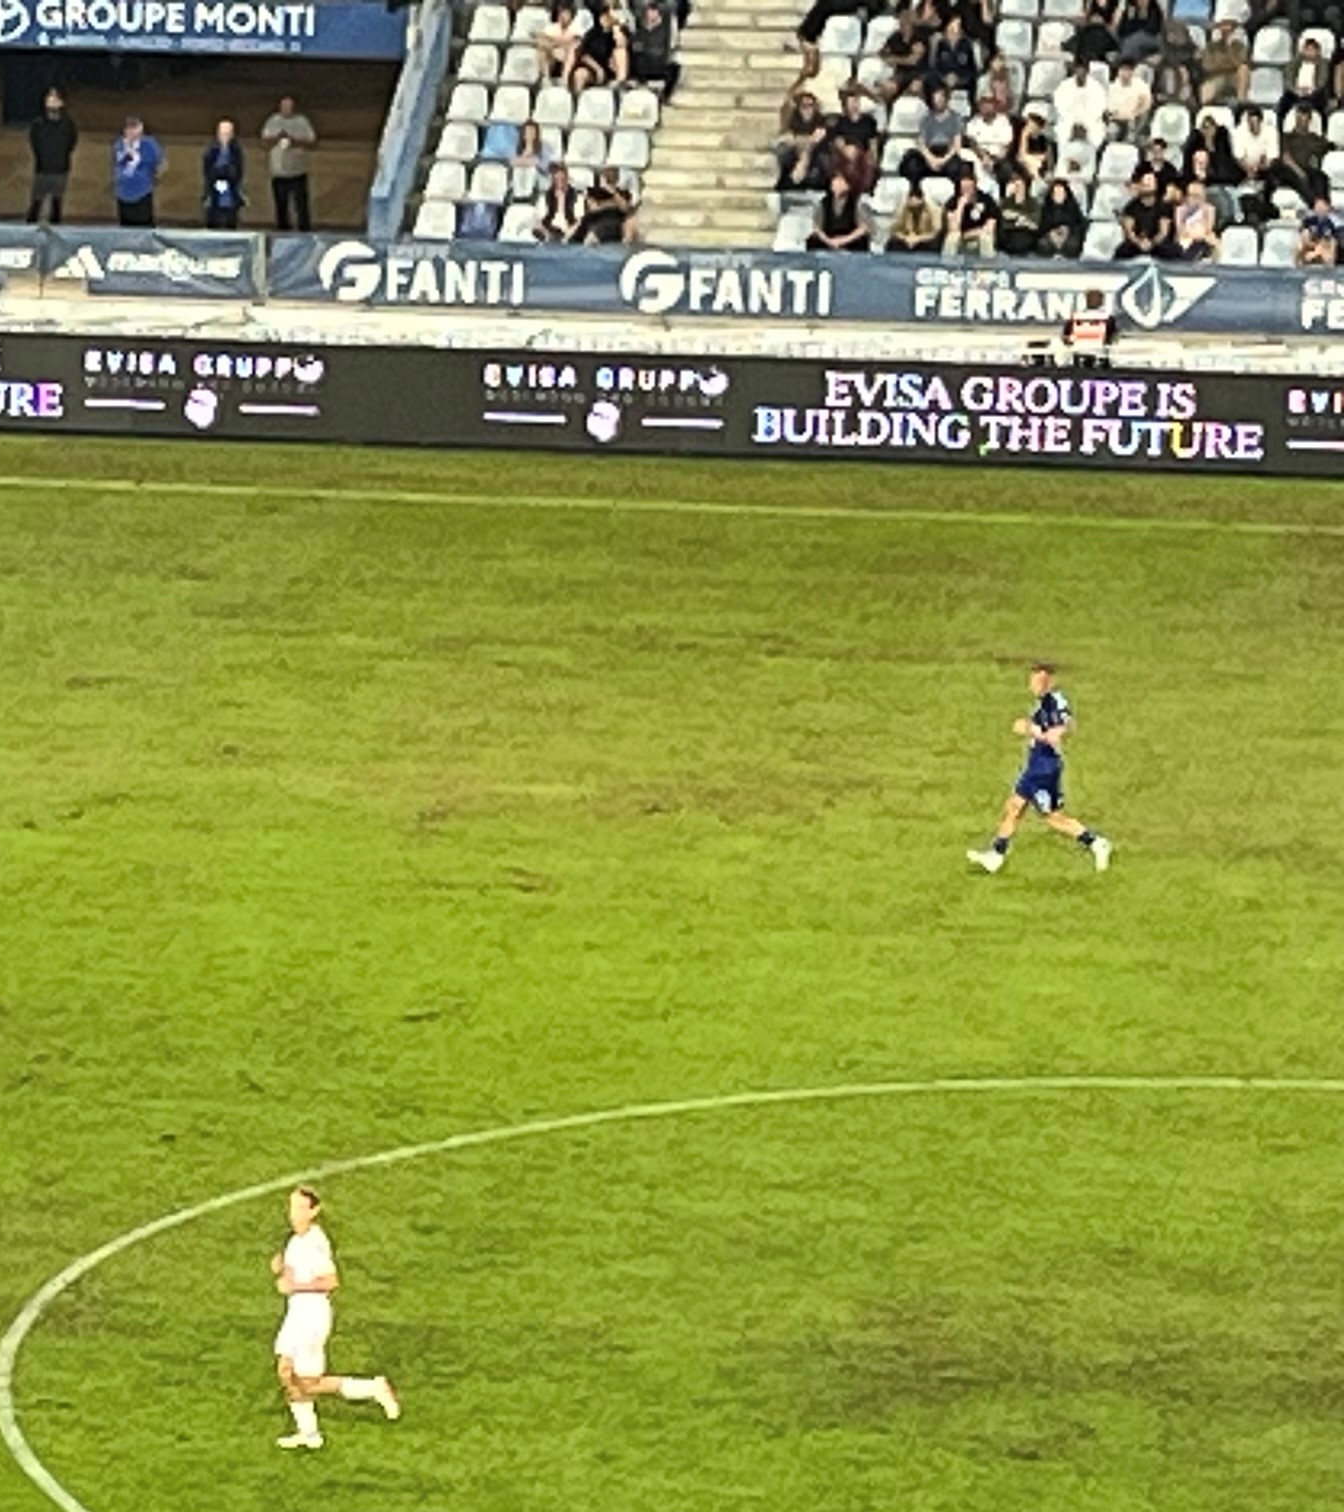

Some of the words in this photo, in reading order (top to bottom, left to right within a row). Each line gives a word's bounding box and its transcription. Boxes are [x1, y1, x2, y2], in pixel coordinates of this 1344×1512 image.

[35, 0, 185, 33] GROUPE
[194, 2, 316, 37] MONTI
[915, 267, 1010, 288] GROUPE
[83, 349, 177, 375] EVISA
[483, 363, 577, 388] EVISA
[824, 369, 954, 411] EVISA
[960, 376, 1148, 417] GROUPE
[1156, 382, 1196, 420] IS
[751, 406, 972, 449] BUILDING
[978, 414, 1072, 452] THE
[1079, 418, 1265, 461] FUTURE
